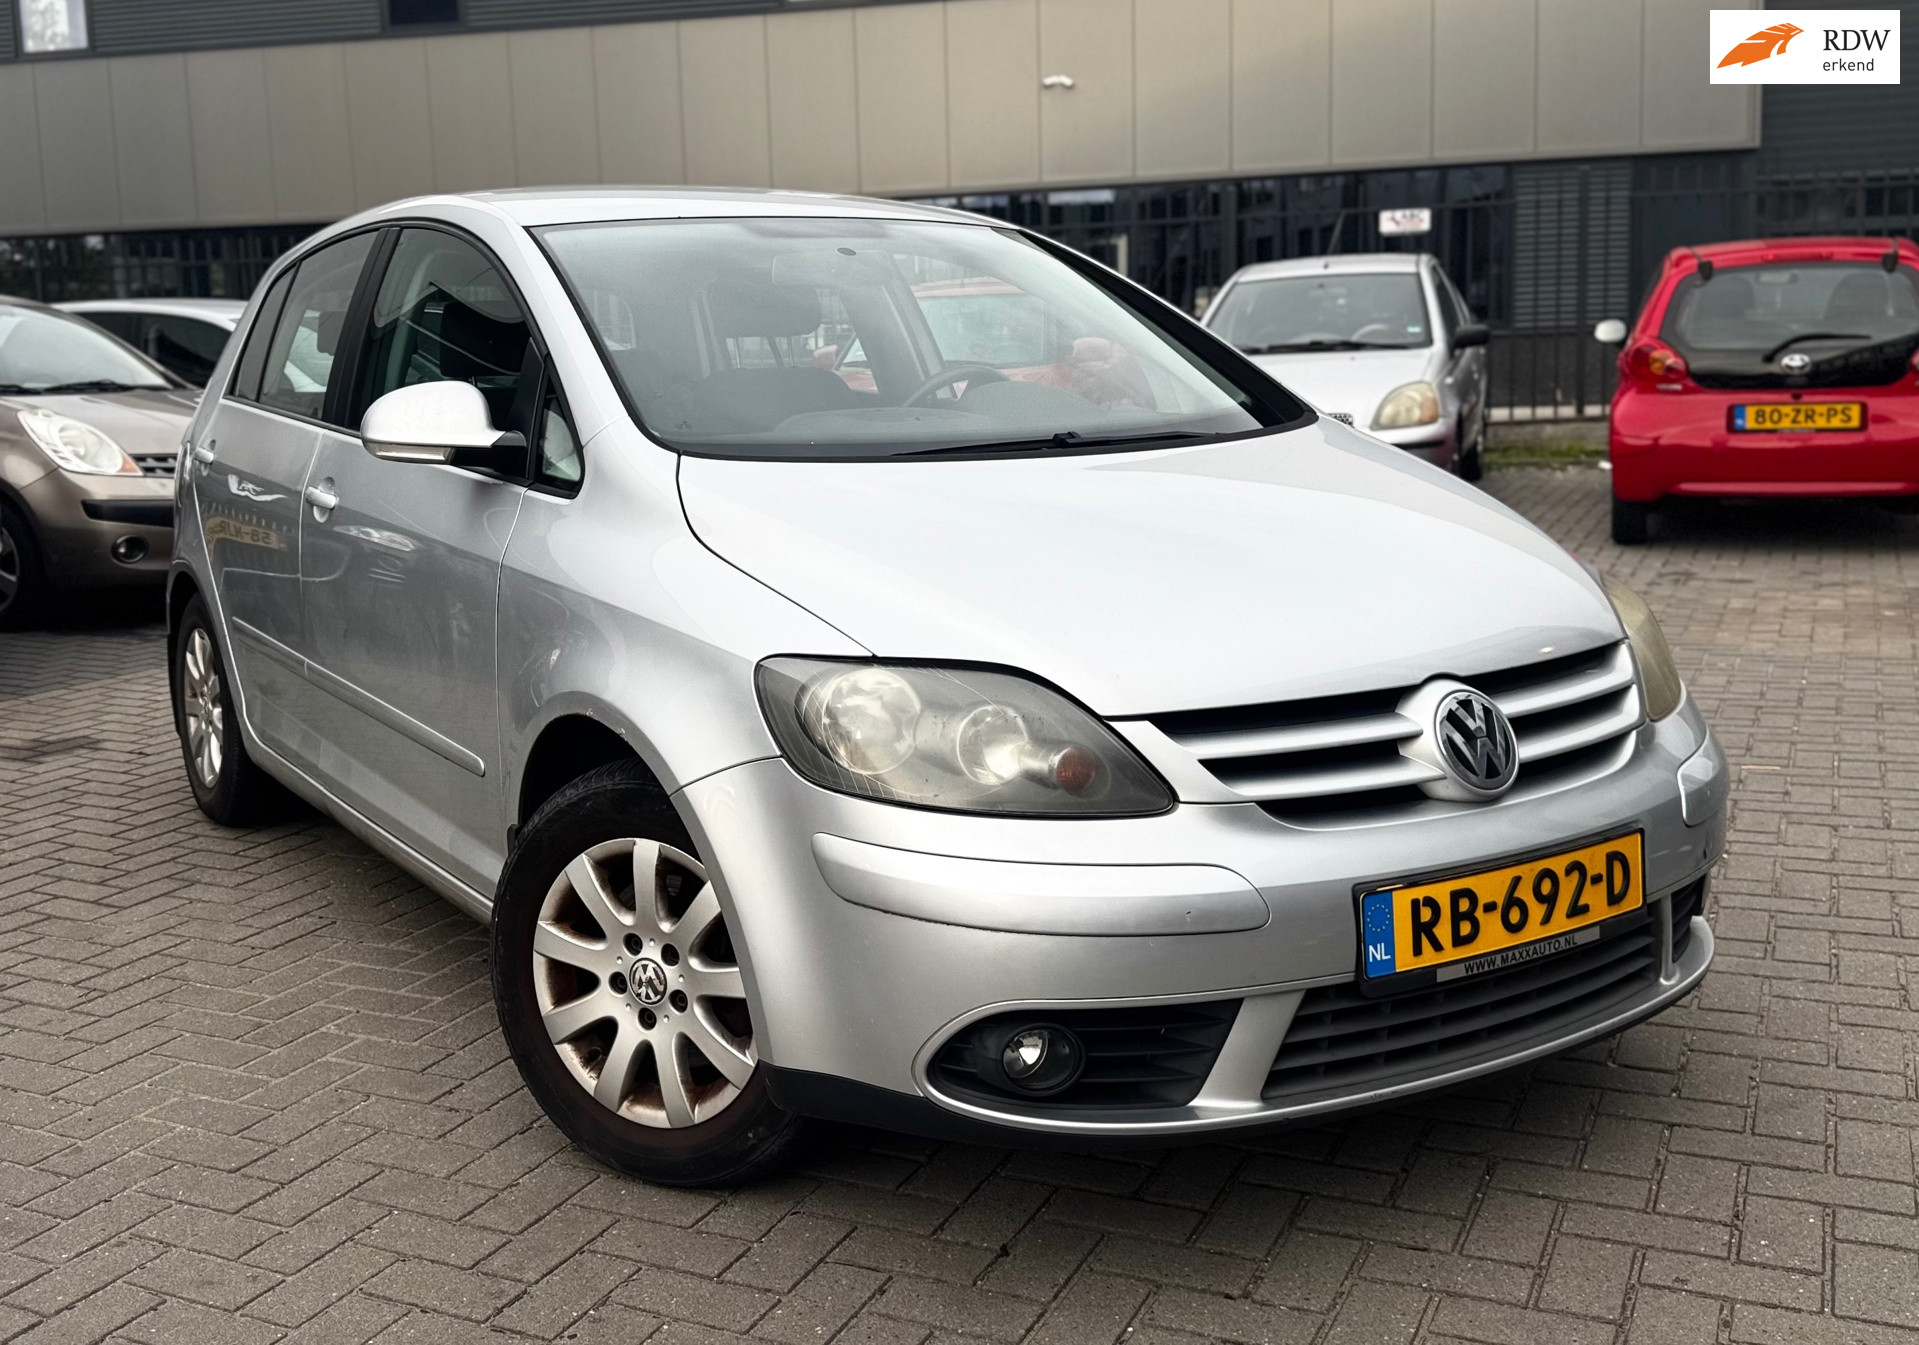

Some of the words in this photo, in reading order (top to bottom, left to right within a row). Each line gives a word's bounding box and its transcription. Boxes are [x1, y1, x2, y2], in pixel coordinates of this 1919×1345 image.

[1754, 406, 1853, 425] 80-ZR-PS
[1410, 850, 1631, 957] RB-692-D
[1368, 943, 1391, 963] NL
[1464, 934, 1578, 975] WWW.MAXXAUTO.NL
